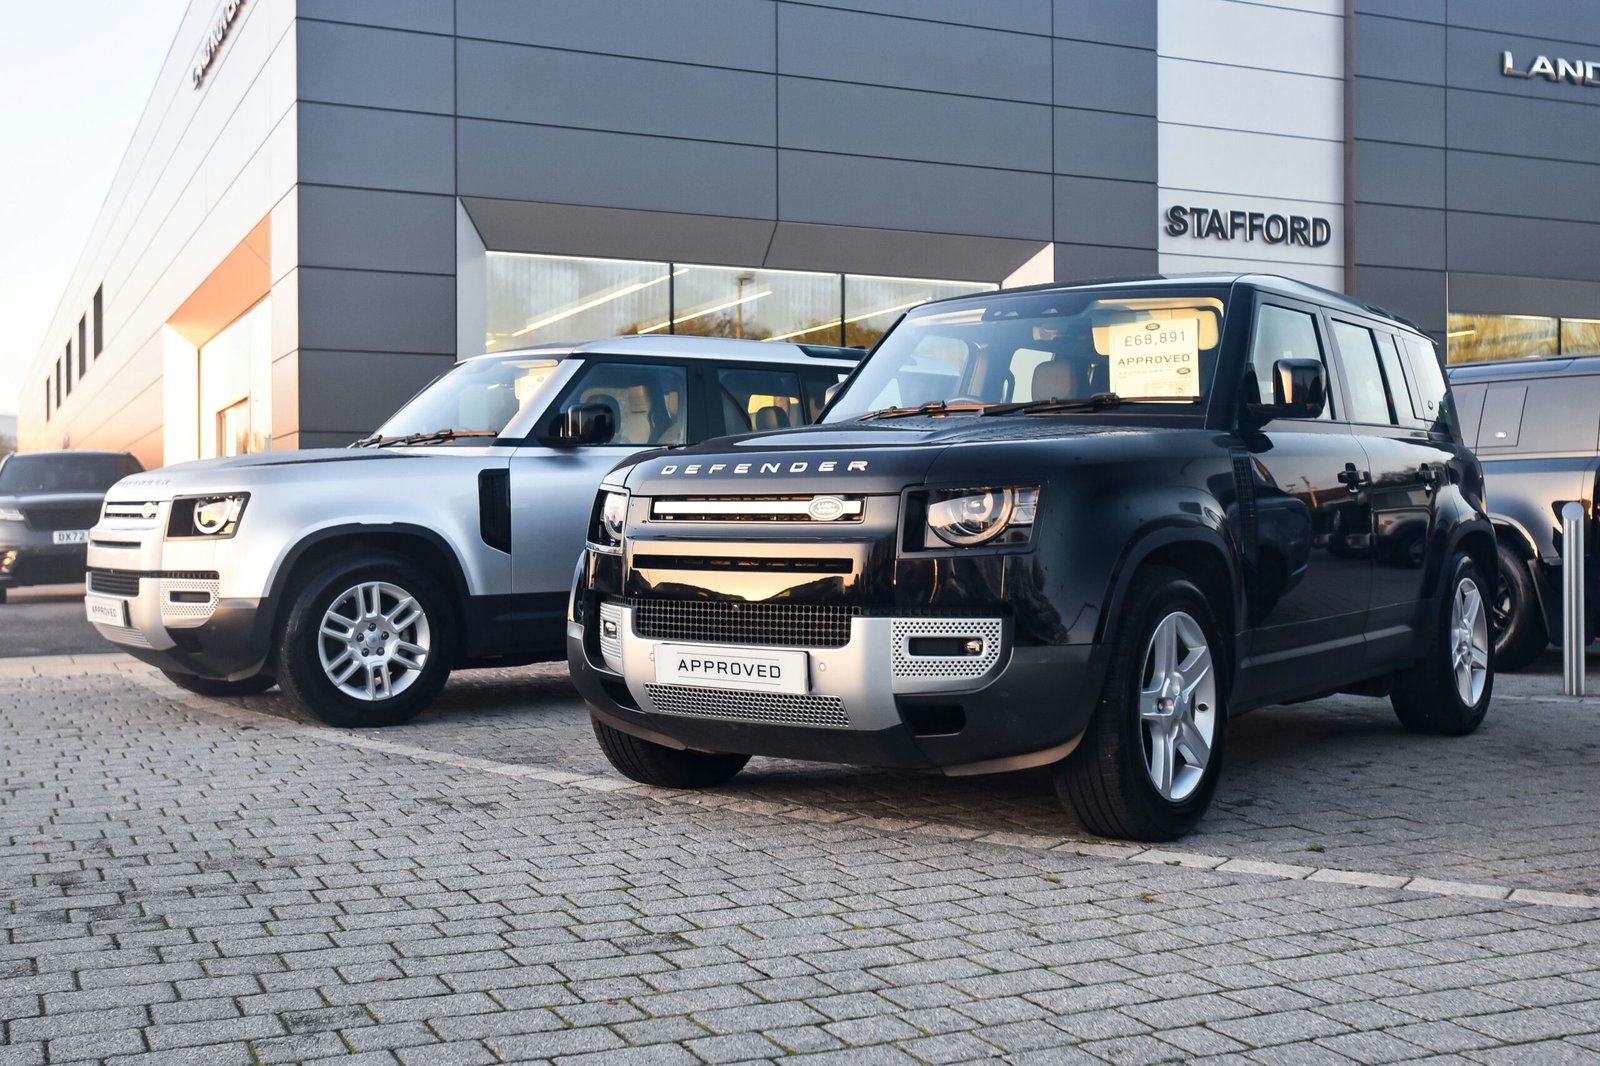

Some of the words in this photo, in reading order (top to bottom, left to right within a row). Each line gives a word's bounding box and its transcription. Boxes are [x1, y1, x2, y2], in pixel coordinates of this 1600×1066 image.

[1166, 205, 1331, 247] STAFFORD
[1124, 331, 1185, 347] £68,891
[1118, 354, 1190, 366] APPROVED
[660, 460, 869, 475] DEFENDER
[92, 605, 117, 618] APPROVED
[678, 659, 781, 679] APPROVED
